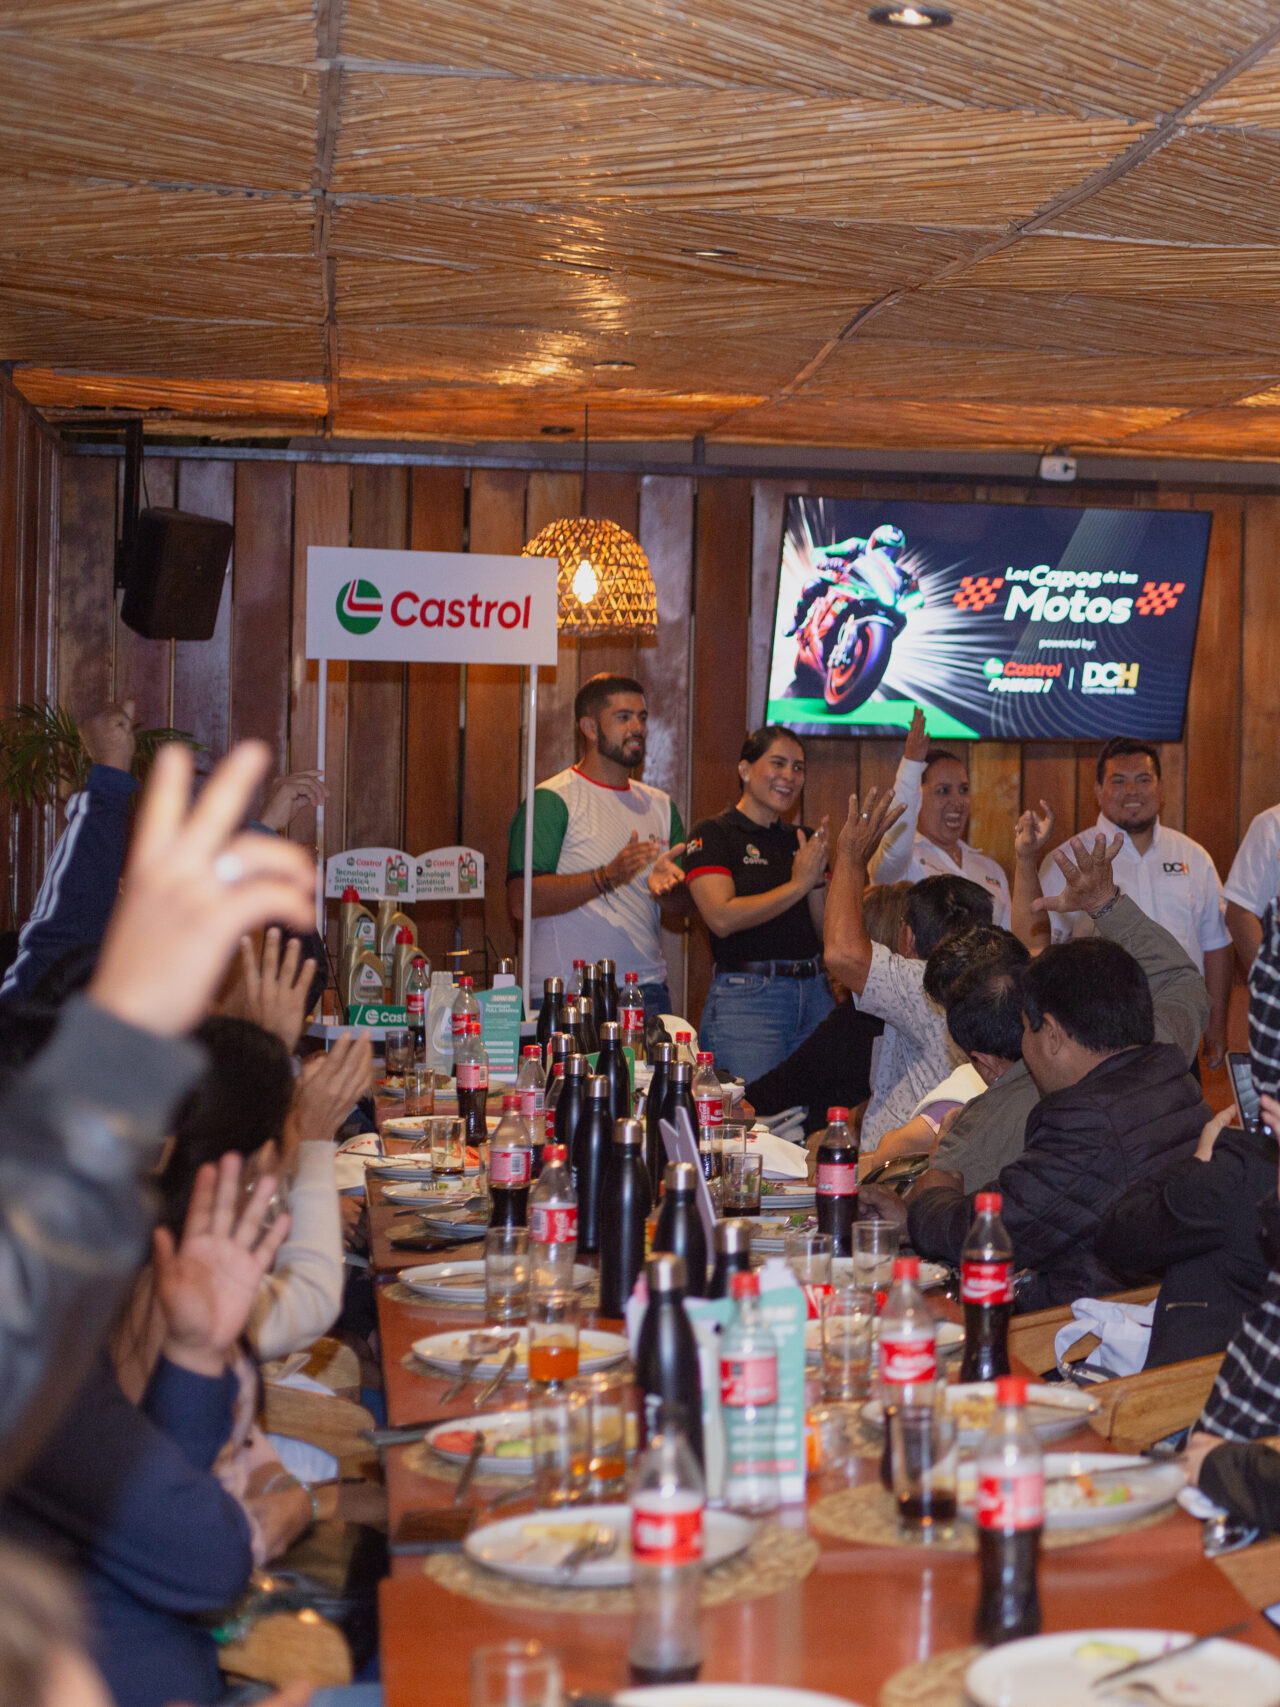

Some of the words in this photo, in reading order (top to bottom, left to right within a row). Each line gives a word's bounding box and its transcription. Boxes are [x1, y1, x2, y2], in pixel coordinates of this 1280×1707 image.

[1029, 564, 1102, 592] Capos
[390, 590, 532, 629] Castrol
[1003, 585, 1134, 624] Motos
[1003, 661, 1063, 677] Castrol
[1081, 661, 1139, 688] DCH
[380, 1011, 407, 1024] Cast
